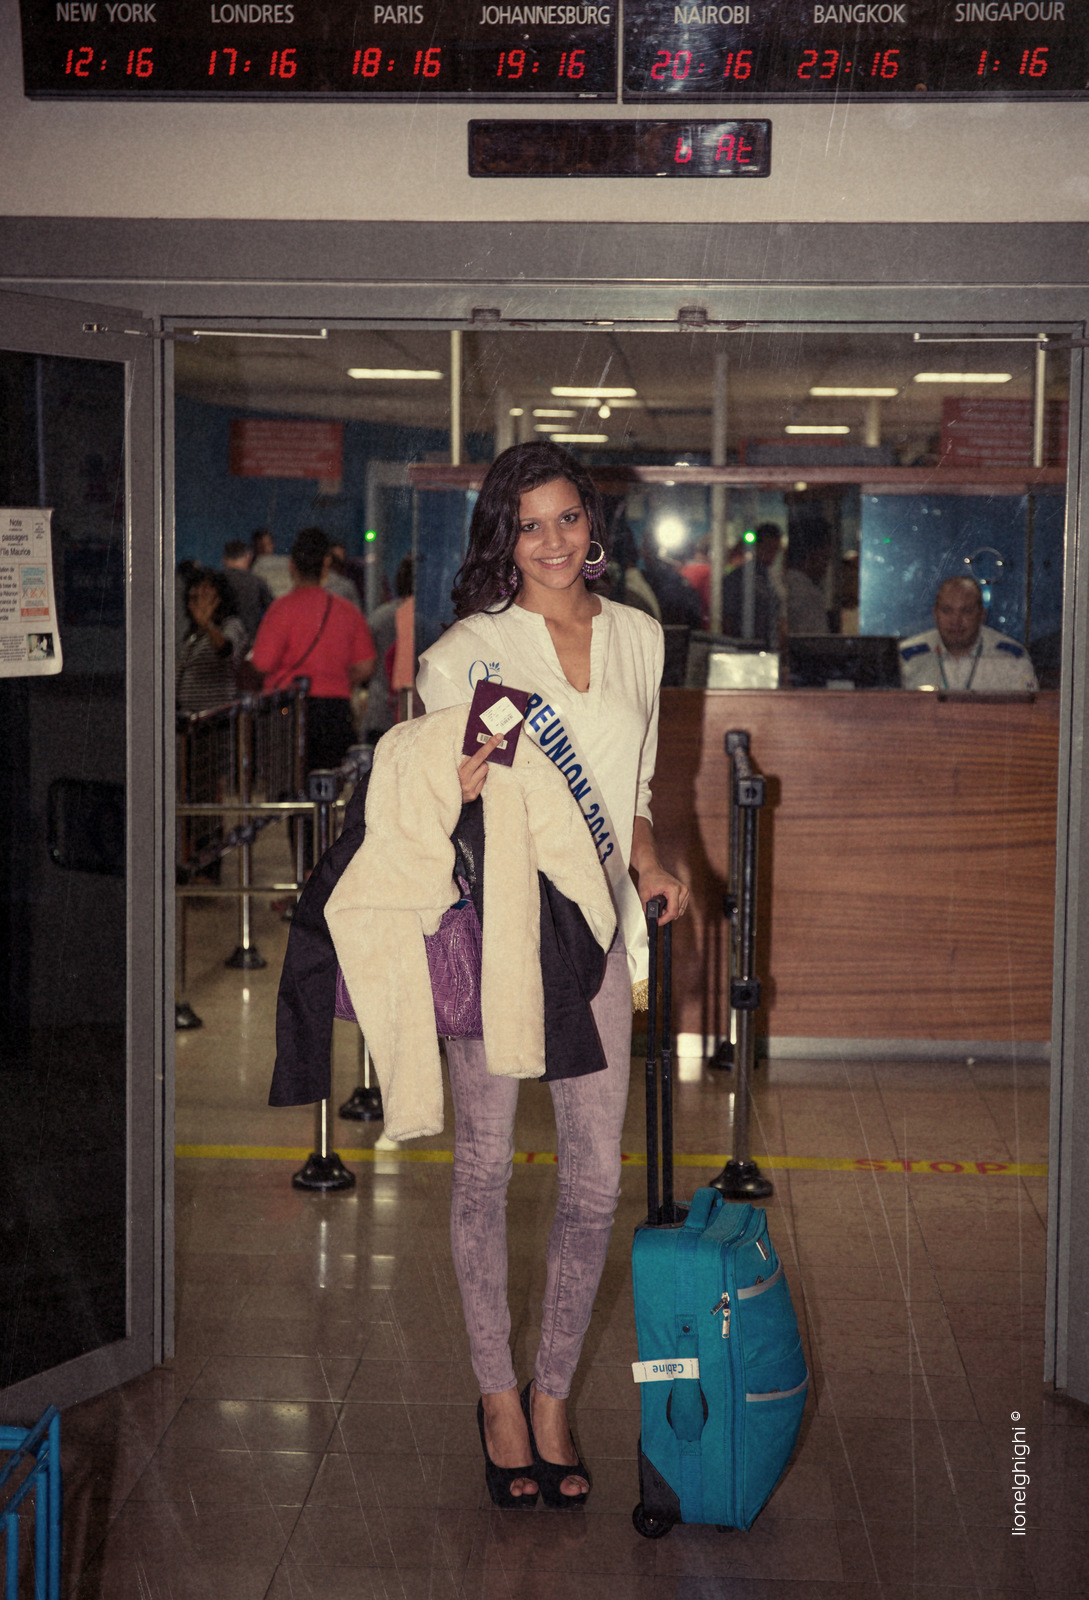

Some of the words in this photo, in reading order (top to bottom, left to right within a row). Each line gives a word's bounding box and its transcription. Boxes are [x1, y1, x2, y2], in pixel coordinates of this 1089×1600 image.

[56, 2, 98, 22] NEW
[104, 2, 157, 23] YORK
[210, 3, 295, 25] LONDRES
[373, 4, 425, 25] PARIS
[479, 5, 611, 25] JOHANNESBURG
[673, 5, 751, 25] NAIROBI
[813, 3, 906, 25] BANGKOK
[954, 1, 1066, 22] SINGAPOUR
[9, 518, 22, 527] Note
[2, 534, 28, 543] passagers
[10, 547, 31, 556] Maurice
[525, 692, 592, 801] REUNION
[584, 803, 615, 866] 2013
[854, 1158, 1008, 1175] STOP
[652, 1362, 684, 1375] Cabine
